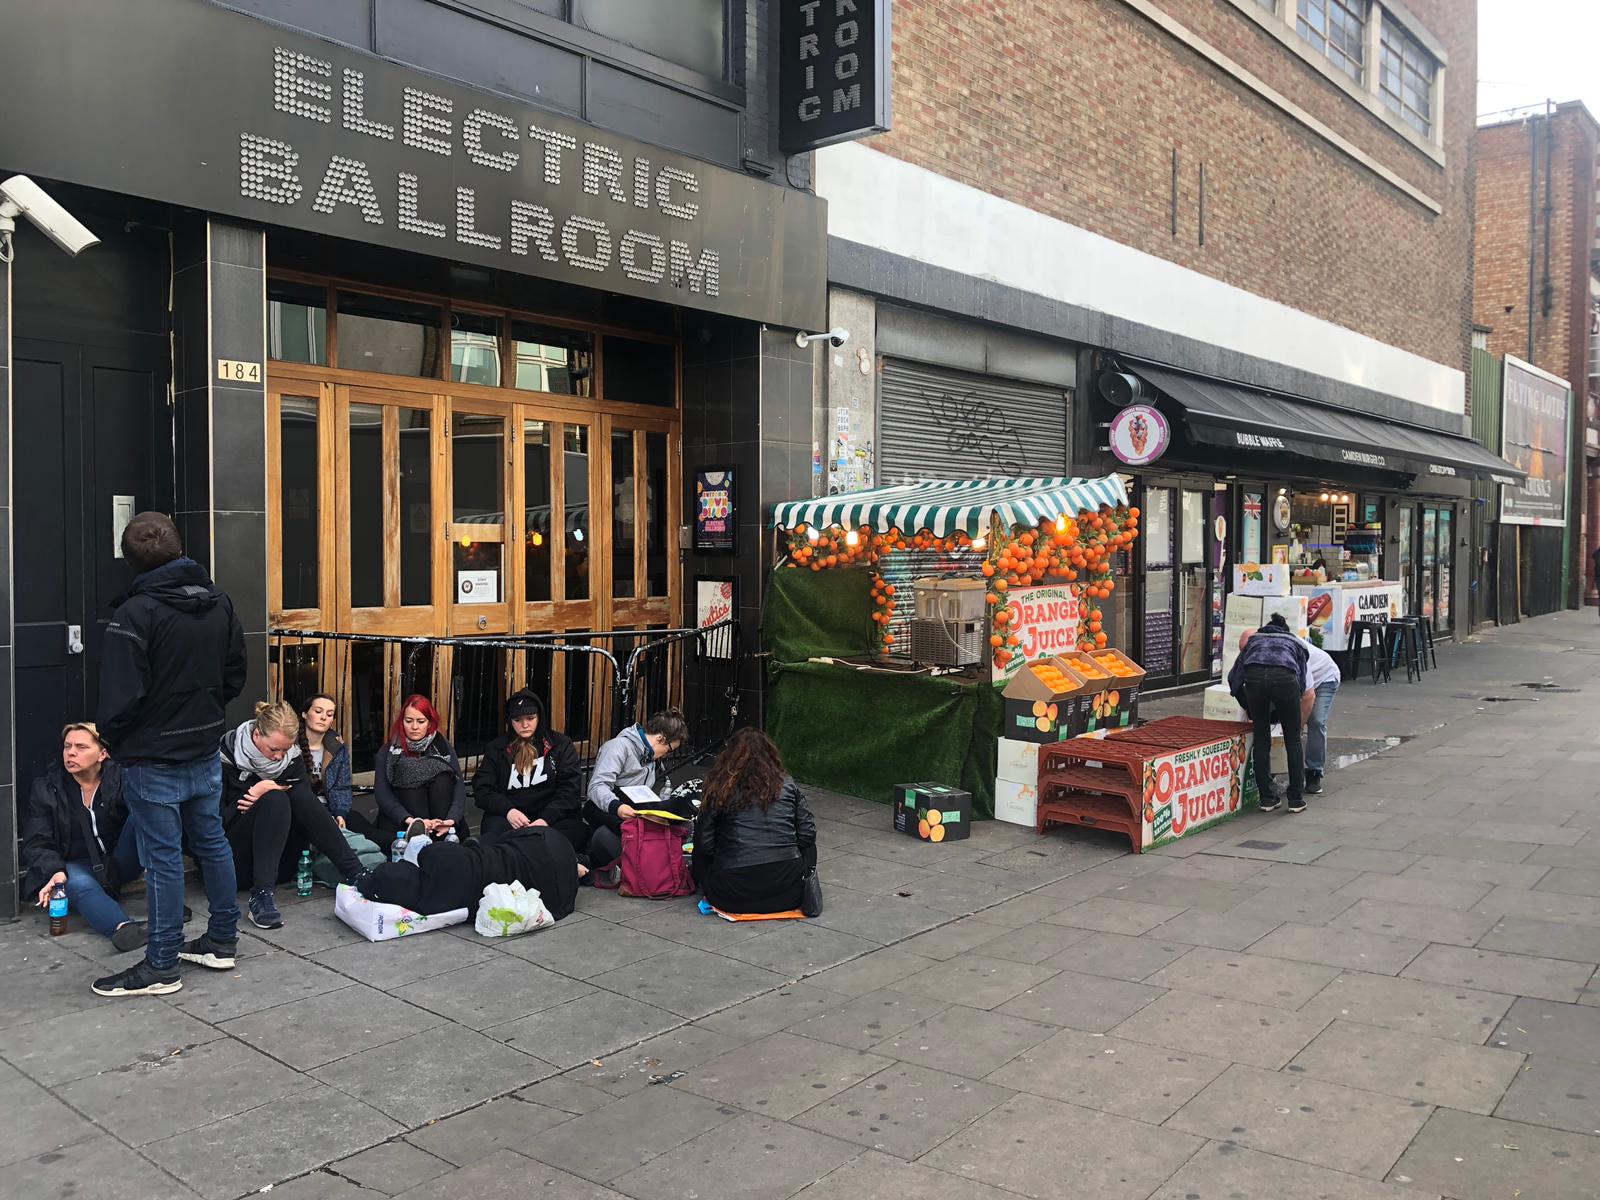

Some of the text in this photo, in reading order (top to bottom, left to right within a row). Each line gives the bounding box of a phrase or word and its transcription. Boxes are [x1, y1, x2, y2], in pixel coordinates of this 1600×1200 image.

[274, 46, 700, 221] ELECTRIC
[240, 132, 720, 297] BALLROOM
[222, 362, 258, 381] 184
[1508, 378, 1566, 420] FLYING LOTUS
[1236, 432, 1285, 448] BUBBLE WAFFLE
[1341, 449, 1362, 462] CAMDEN
[1361, 452, 1378, 464] BURGER
[1021, 589, 1067, 605] THE ORIGINAL
[1358, 594, 1389, 610] CAMDEN
[1006, 600, 1078, 633] ORANGE
[1022, 627, 1075, 657] JUICE
[1174, 740, 1231, 765] FRESHLY SQUEEZED
[1155, 752, 1231, 803] ORANGE
[1153, 808, 1171, 828] 100%
[1171, 787, 1226, 834] JUICE
